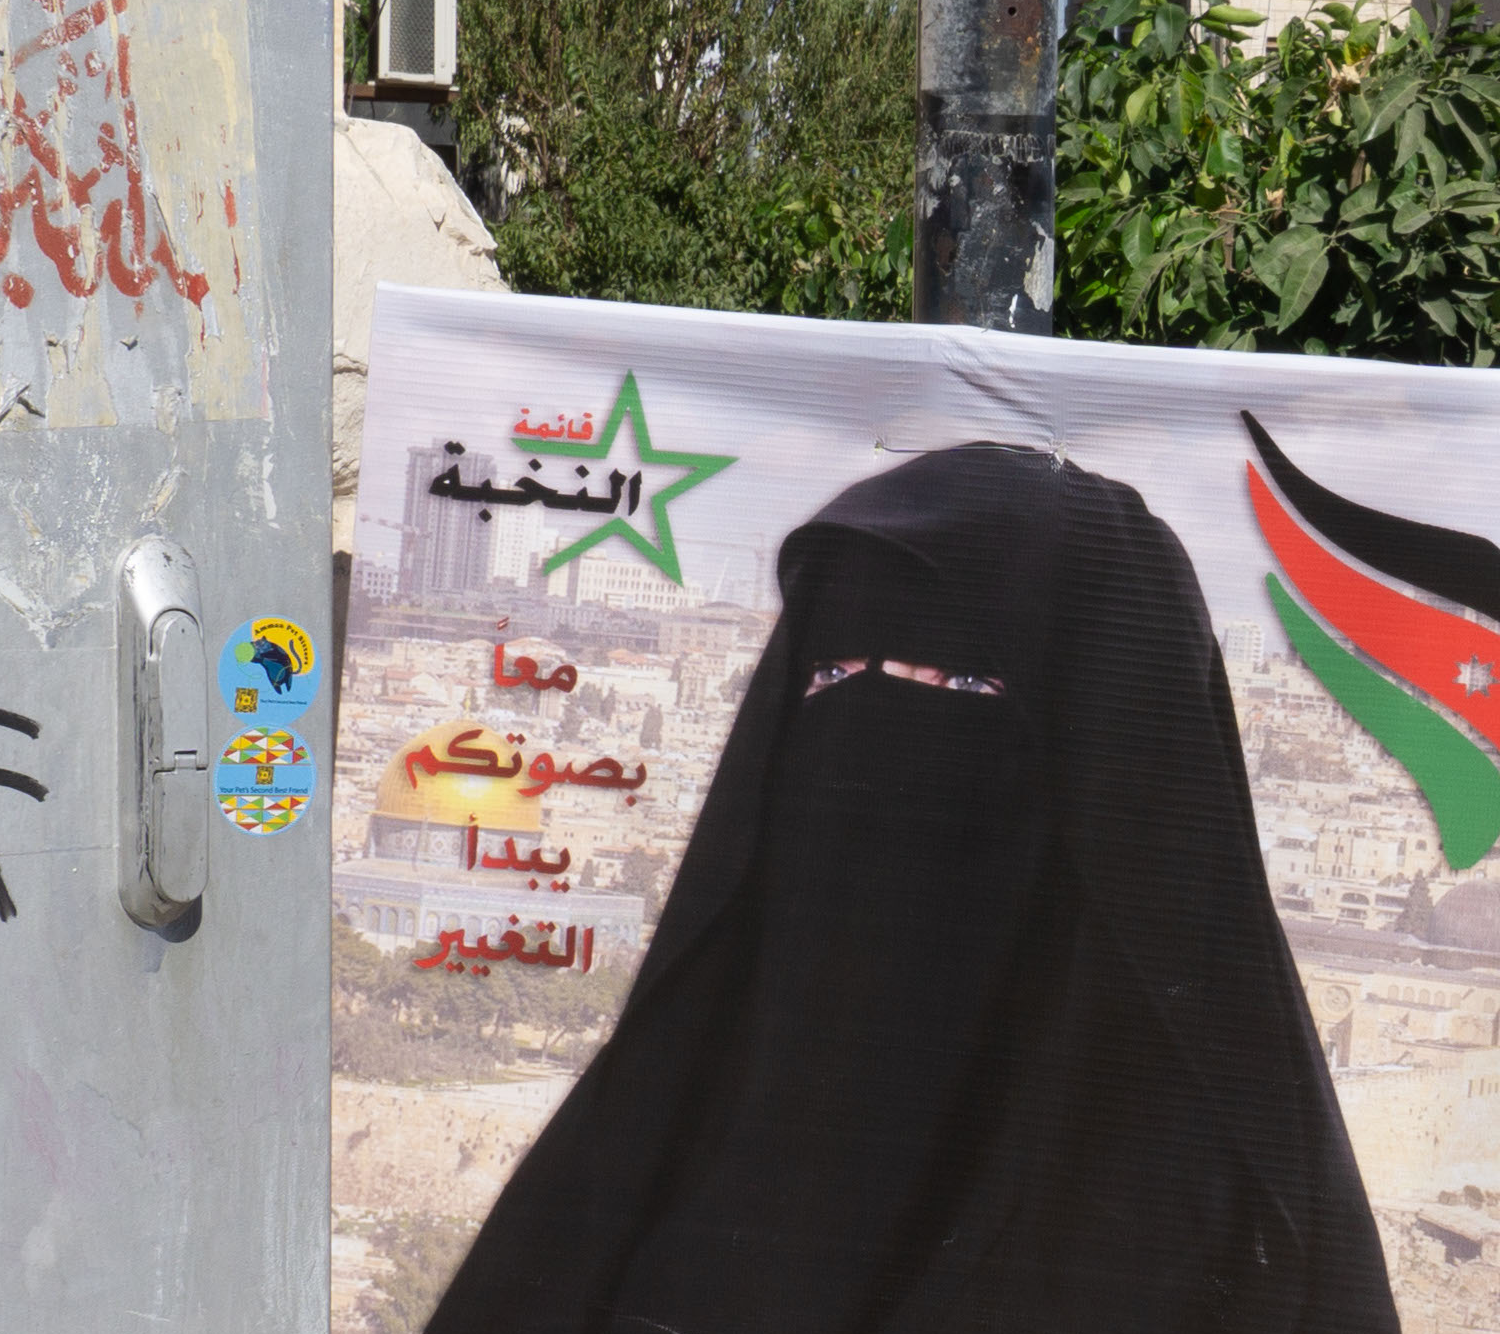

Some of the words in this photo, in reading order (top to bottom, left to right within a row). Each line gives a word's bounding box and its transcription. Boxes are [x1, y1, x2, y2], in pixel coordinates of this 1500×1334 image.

[513, 408, 594, 441] قائمة
[428, 440, 643, 523] النخبة
[405, 729, 648, 807] بصوتكم
[467, 813, 572, 894] يبدأ
[413, 914, 595, 977] التغيير
